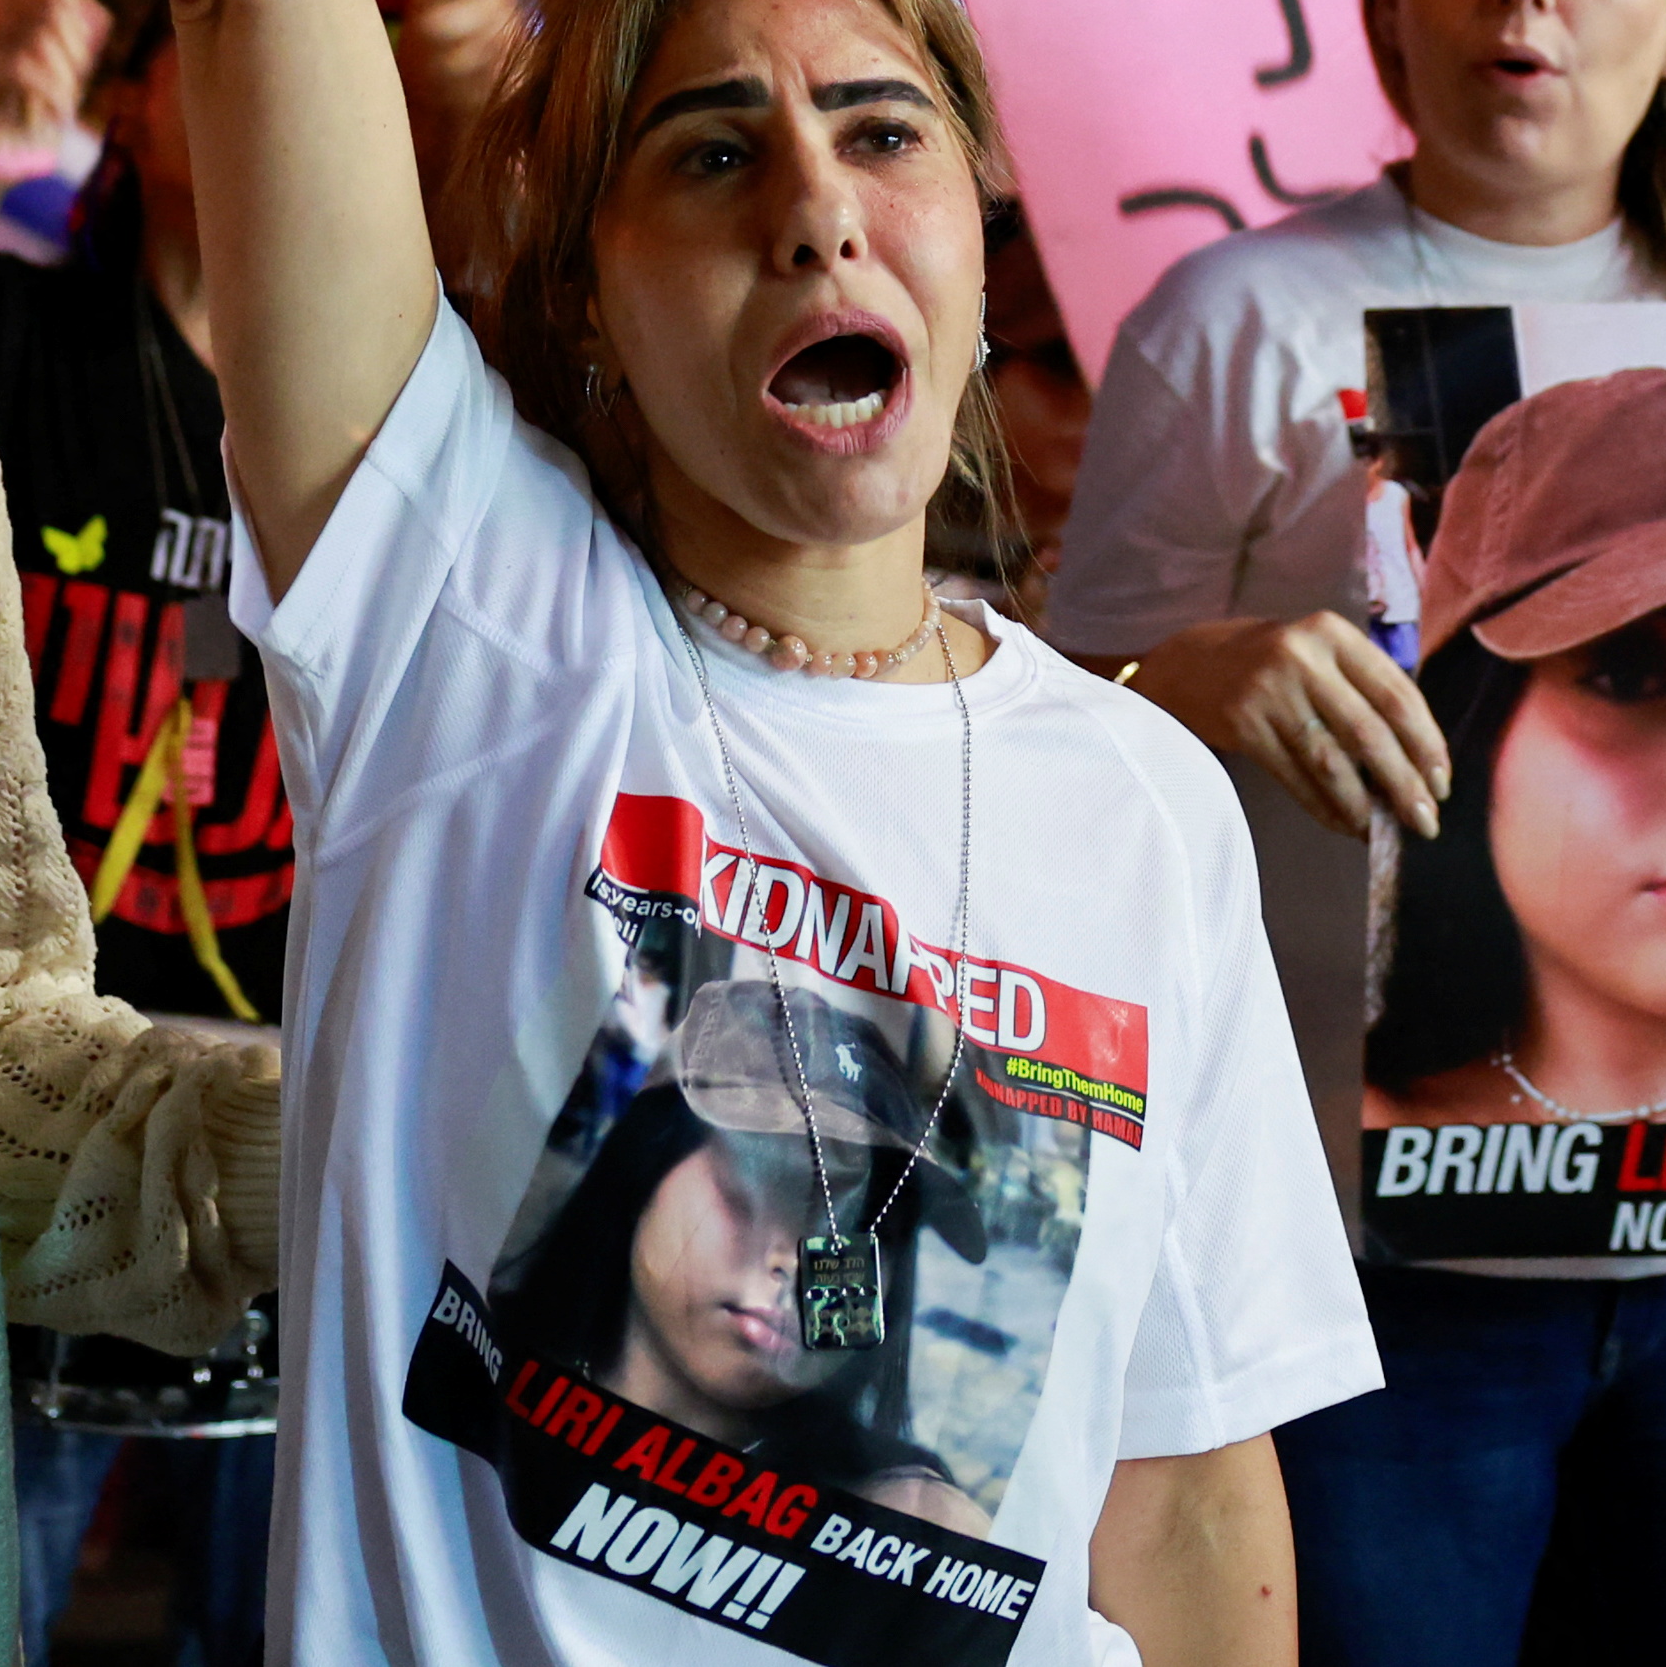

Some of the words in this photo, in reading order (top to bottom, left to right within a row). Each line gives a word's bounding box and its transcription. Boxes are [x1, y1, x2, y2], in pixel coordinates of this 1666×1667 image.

[1006, 1057, 1144, 1114] #BringThemHome
[1066, 1097, 1090, 1124] BY
[1092, 1108, 1142, 1148] HAMAS
[1377, 1125, 1602, 1197] BRING
[433, 1286, 503, 1385] BRING
[504, 1360, 626, 1457] LIRI
[613, 1425, 820, 1540] ALBAG
[810, 1513, 931, 1585] BACK
[923, 1555, 1036, 1621] HOME
[549, 1482, 806, 1631] NOW!!
